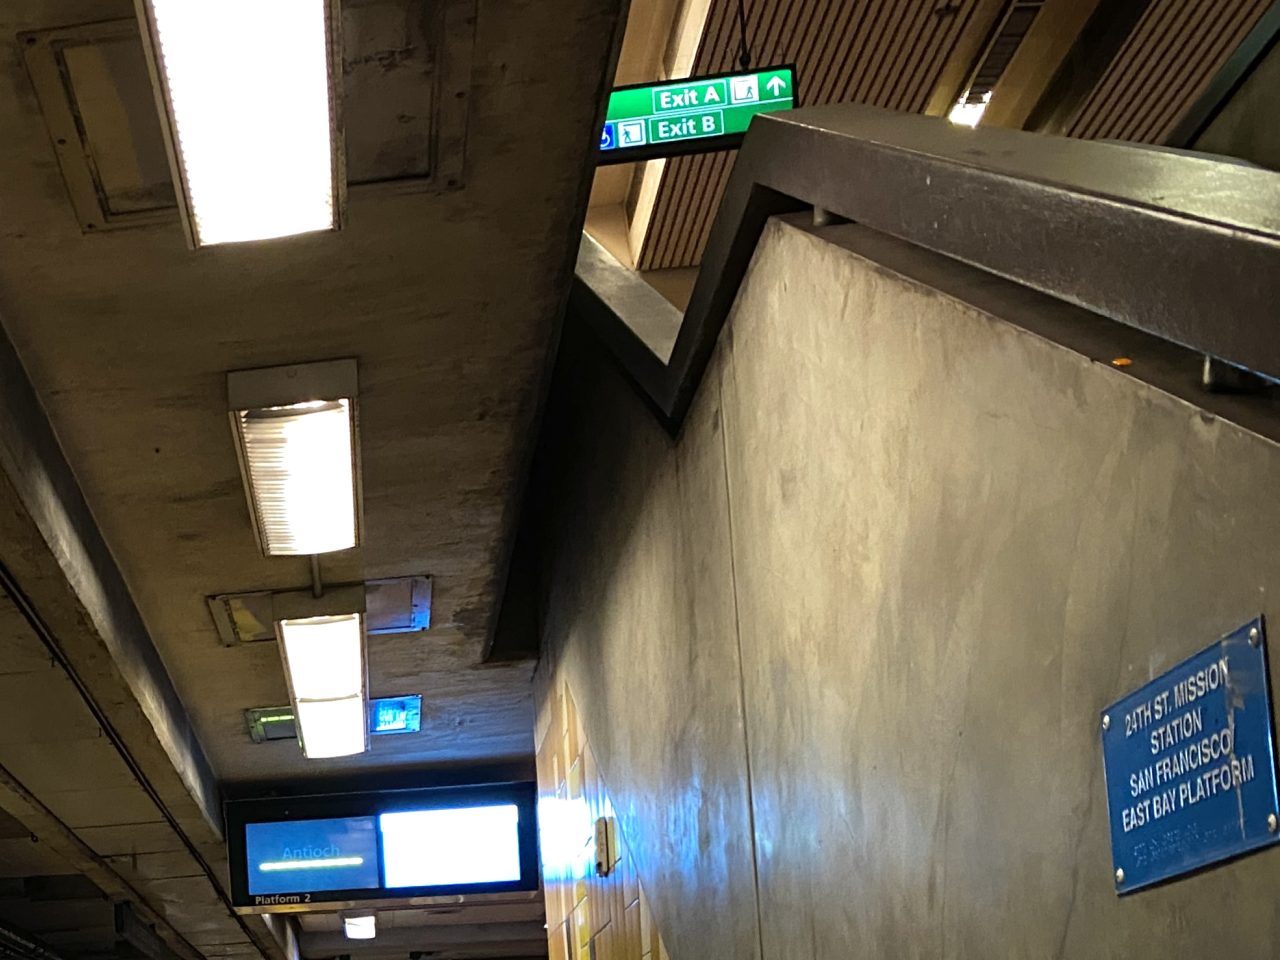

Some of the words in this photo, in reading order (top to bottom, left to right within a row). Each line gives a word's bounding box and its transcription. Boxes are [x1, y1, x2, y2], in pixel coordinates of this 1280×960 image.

[660, 91, 699, 109] Exit
[704, 86, 720, 102] A
[658, 120, 696, 138] Exit
[701, 116, 716, 132] B
[1125, 702, 1152, 738] 24TH
[1154, 689, 1172, 720] ST.
[1174, 656, 1229, 708] MISSION
[1150, 707, 1203, 755] STATION
[1130, 765, 1154, 798] SAN
[1155, 728, 1232, 780] FRANCISCO
[1122, 800, 1151, 833] EAST
[1153, 787, 1177, 819] BAY
[1179, 754, 1255, 808] PLATFORM
[282, 844, 339, 859] Antioch
[255, 895, 300, 904] Platform
[304, 894, 311, 903] 2
